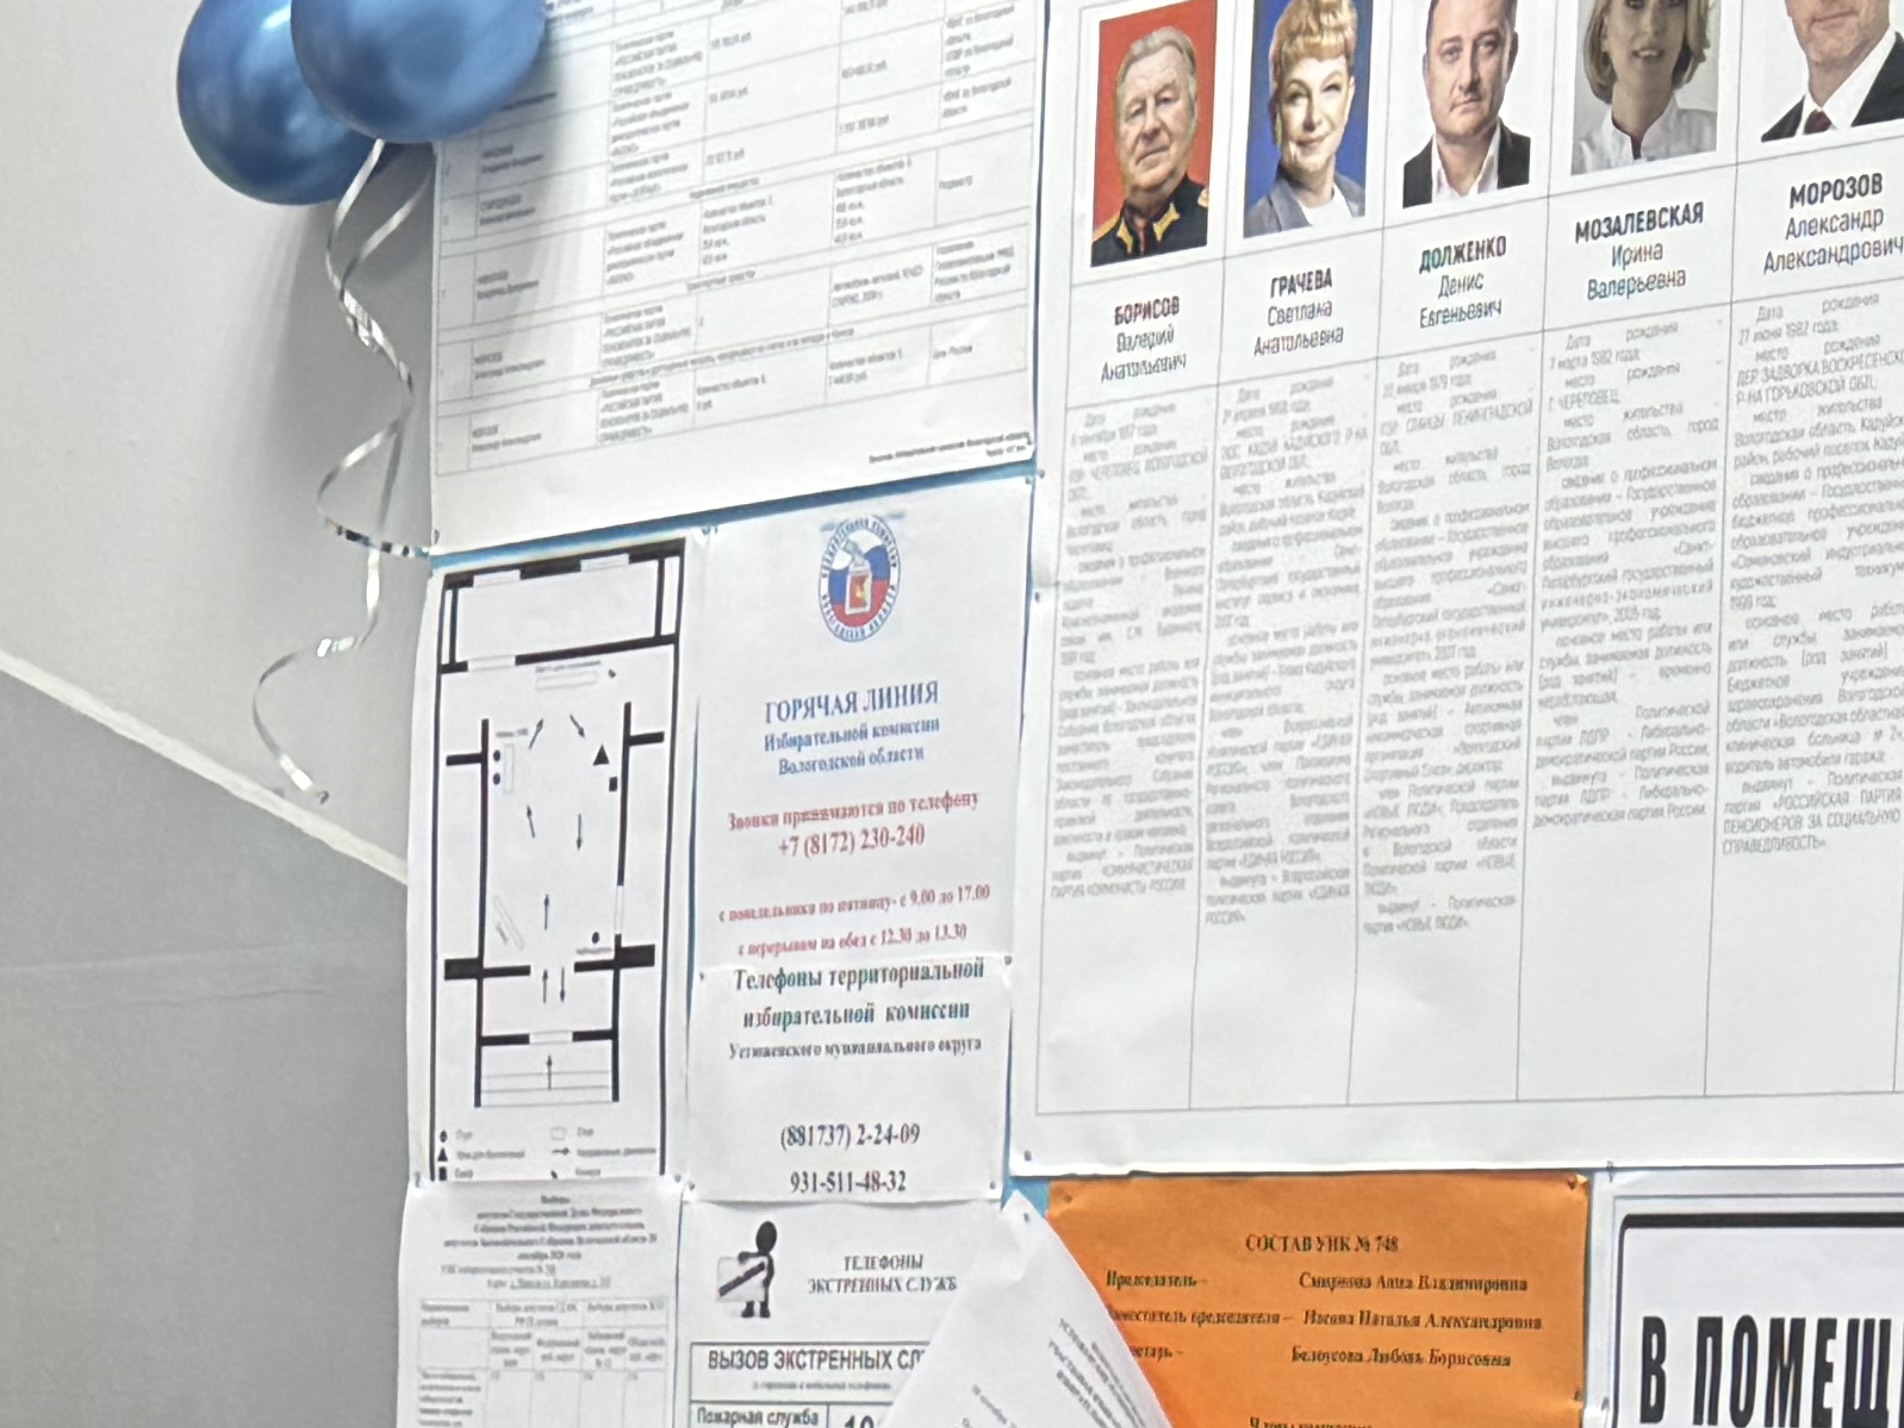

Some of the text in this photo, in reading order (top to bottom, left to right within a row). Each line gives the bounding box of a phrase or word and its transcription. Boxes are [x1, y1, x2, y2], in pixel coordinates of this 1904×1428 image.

[1790, 173, 1883, 208] МОРОЗОВ
[1575, 201, 1703, 243] МОЗАЛЕВСКАЯ
[1785, 208, 1884, 240] Александр
[1419, 235, 1506, 273] ДОЛЖЕНКО
[1612, 243, 1663, 270] Ирина
[1763, 236, 1904, 274] Александрович
[1271, 268, 1332, 298] ГРАЧЕВА
[1438, 272, 1484, 298] Денис
[1587, 269, 1686, 300] Валерьевна
[1114, 296, 1179, 325] БОРИСОВ
[1268, 300, 1332, 326] Светлана
[1420, 299, 1501, 328] Евгеньевич
[1254, 327, 1344, 357] Анатольевна
[765, 680, 938, 723] ГОРЯЧАЯ ЛИНИЯ
[764, 718, 940, 752] Избирательной комиссии
[779, 747, 924, 775] Вологодской области
[728, 791, 980, 830] Звонки принимаются по телефону
[779, 823, 925, 858] +7 (8172) 230-240
[719, 910, 724, 922] с
[900, 894, 907, 908] с
[910, 890, 935, 905] 9.00
[939, 892, 953, 904] до
[958, 884, 990, 902] 17.00
[738, 944, 743, 956] с
[821, 937, 835, 950] на
[839, 932, 866, 948] обед
[870, 935, 876, 946] с
[881, 928, 912, 945] 12.30
[916, 930, 930, 943] до
[734, 957, 984, 994] Телефоны территориальной
[744, 1002, 970, 1031] избирательной комиссии
[938, 1037, 982, 1056] округа
[780, 1123, 920, 1151] (881737) 2-24-09
[791, 1170, 906, 1193] 931-511-48-32
[1246, 1235, 1399, 1252] СОСТАВ УИК № 748
[844, 1254, 923, 1271] ТЕЛЕФОНЫ
[809, 1276, 957, 1293] ЭКСТРЕННЫХ СЛУЖБ
[1107, 1270, 1527, 1295] Председатель Смирнова Анна Владимировна
[1191, 1311, 1280, 1327] председателя
[1359, 1310, 1420, 1328] Наталья
[1424, 1313, 1542, 1332] Александровна
[708, 1350, 769, 1370] ВЫЗОВ
[774, 1350, 892, 1370] ЭКСТРЕННЫХ
[1292, 1345, 1511, 1368] Белоусова Любовь Борисовна
[1640, 1316, 1667, 1424] В
[697, 1407, 763, 1426] Пожарная
[767, 1409, 818, 1428] служба
